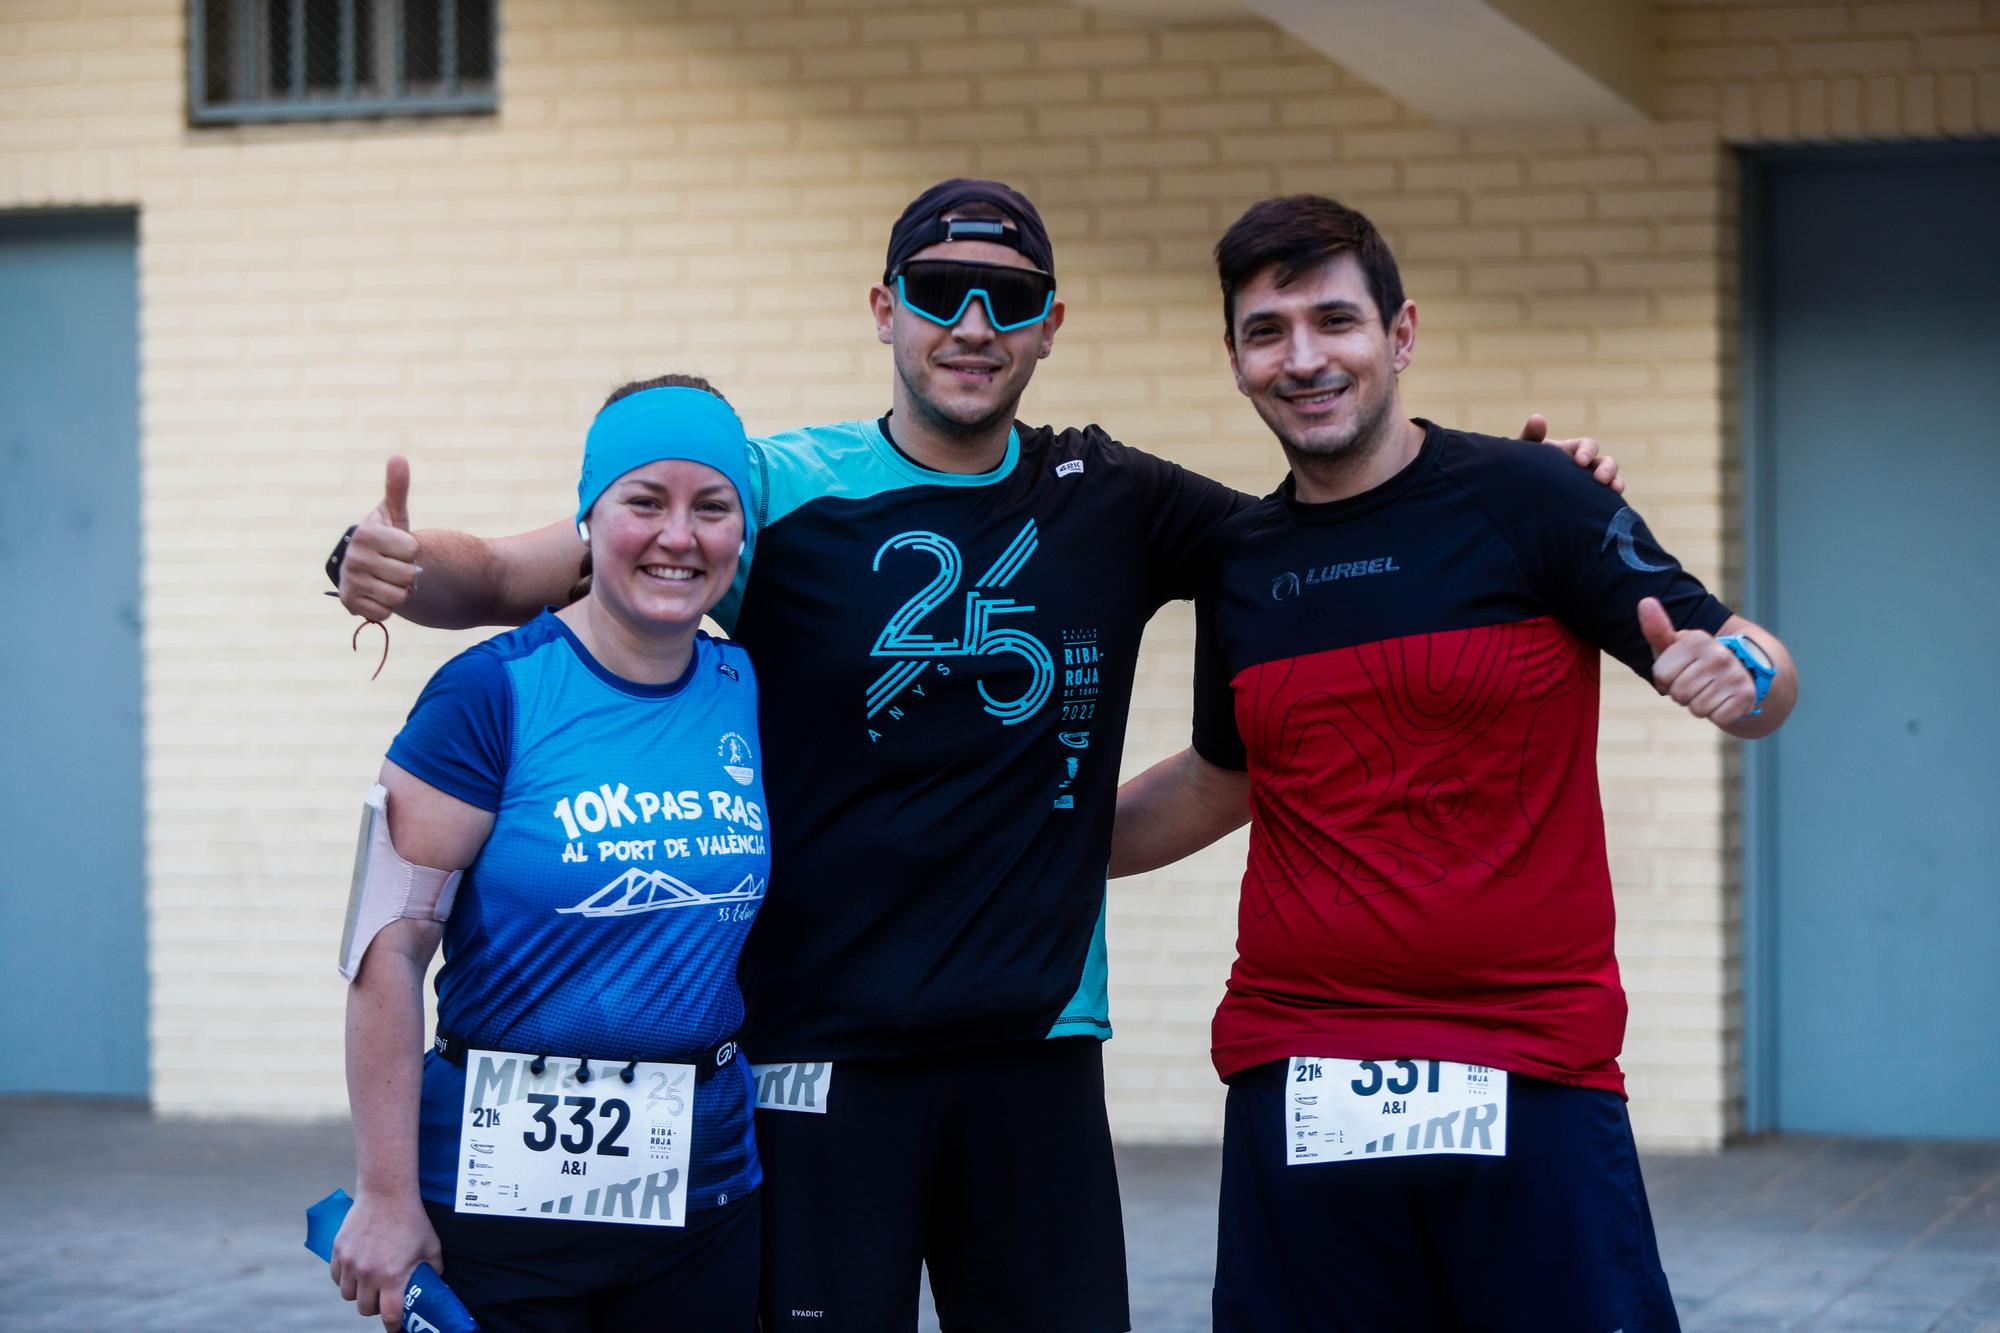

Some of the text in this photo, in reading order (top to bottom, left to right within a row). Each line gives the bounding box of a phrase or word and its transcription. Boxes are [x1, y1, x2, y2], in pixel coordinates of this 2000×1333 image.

[1306, 556, 1400, 584] LURBEL
[868, 518, 1055, 726] 25
[867, 662, 950, 742] ANYS
[1062, 704, 1095, 721] 2022
[553, 782, 763, 840] 10K PAS RAS
[562, 842, 588, 863] AL
[597, 839, 656, 862] PORT
[664, 838, 691, 859] DE
[718, 907, 730, 921] 33
[1382, 1100, 1407, 1114] A&I
[523, 1093, 631, 1157] 332
[561, 1160, 587, 1175] A&I
[792, 1309, 824, 1318] EVADICT
